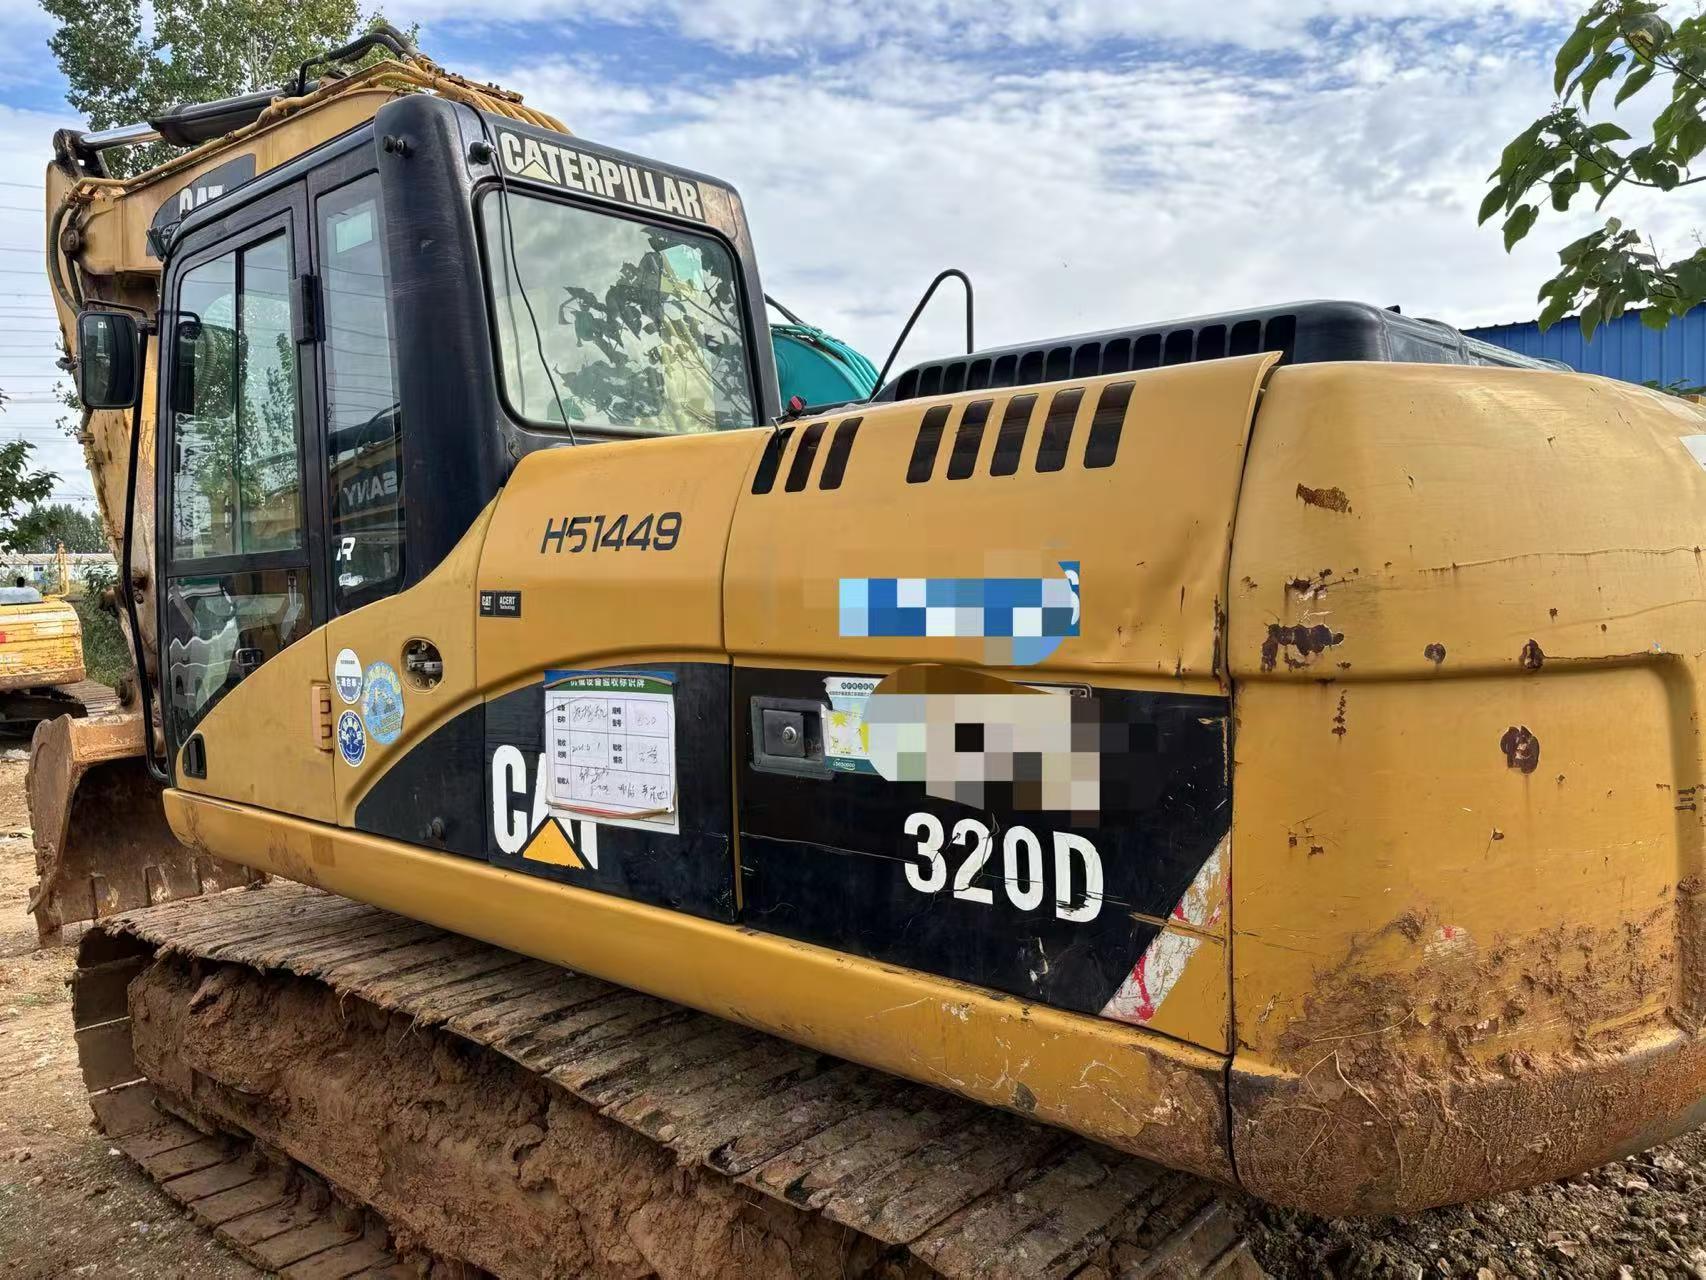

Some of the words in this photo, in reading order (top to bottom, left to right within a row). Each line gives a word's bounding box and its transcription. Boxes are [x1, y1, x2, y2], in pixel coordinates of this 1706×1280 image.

[500, 132, 704, 219] CATERPILLAR
[540, 512, 682, 554] H51449
[481, 595, 493, 606] CAT
[499, 596, 516, 605] ACERT
[904, 812, 1104, 923] 320D
